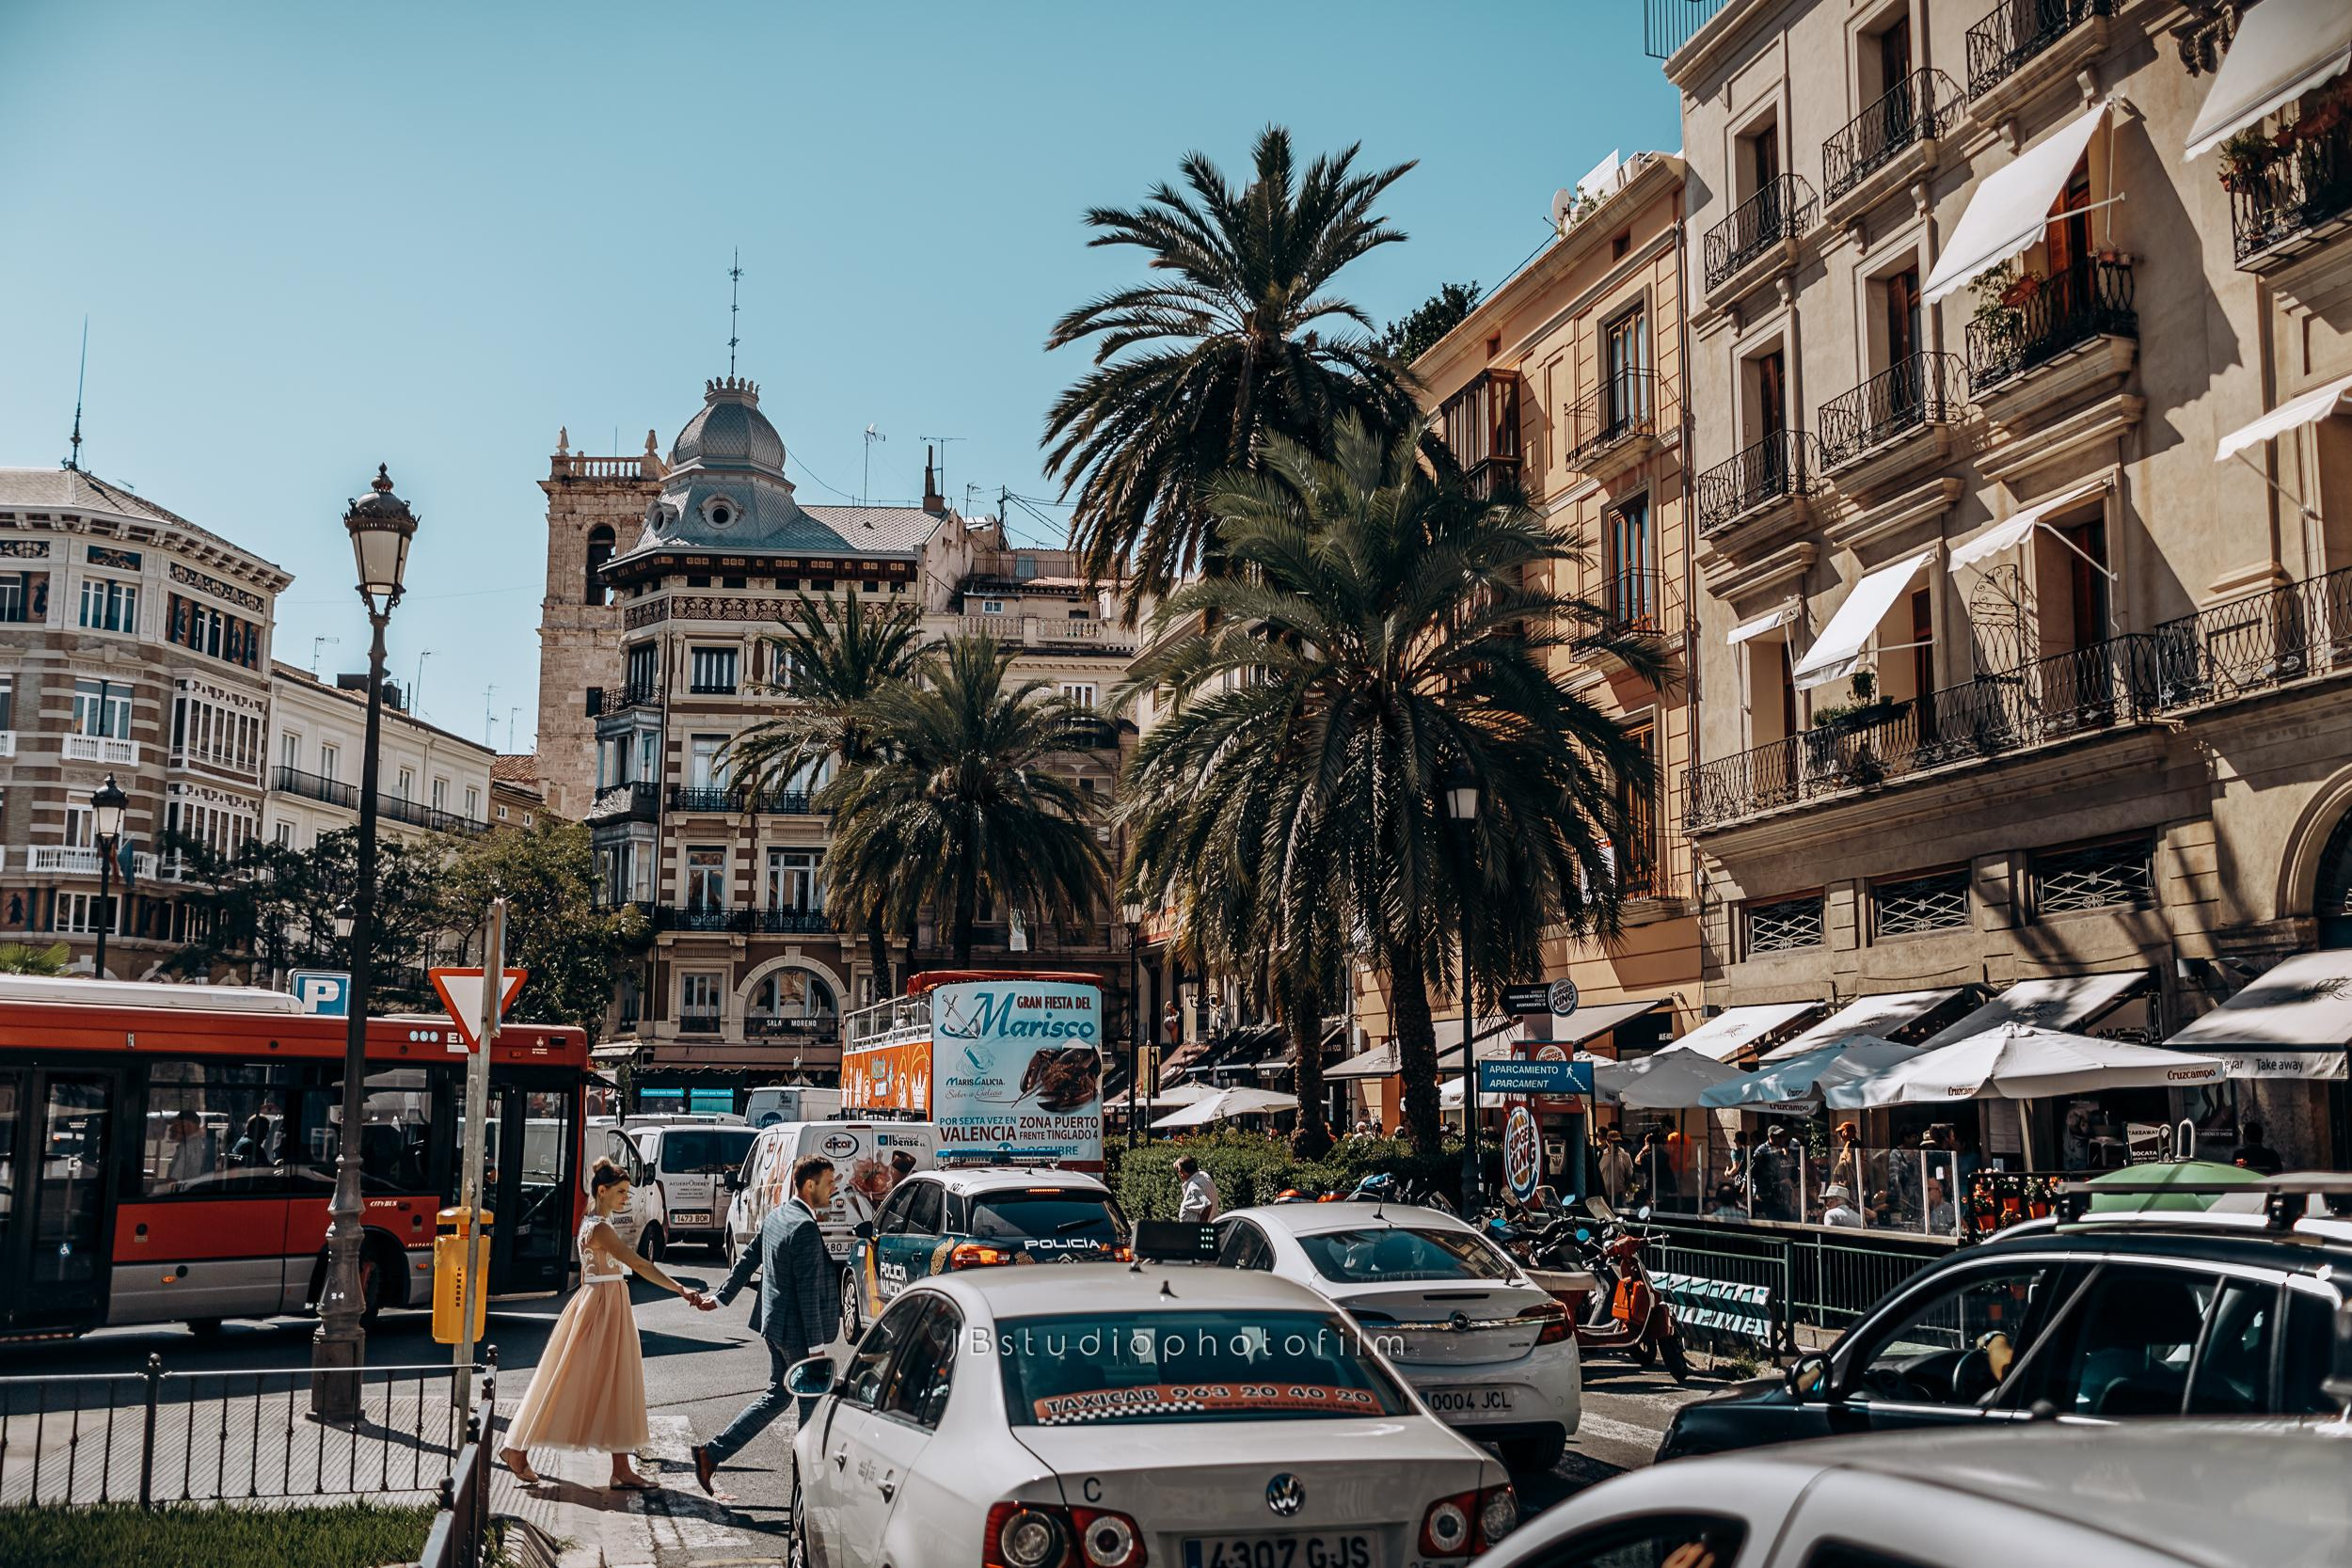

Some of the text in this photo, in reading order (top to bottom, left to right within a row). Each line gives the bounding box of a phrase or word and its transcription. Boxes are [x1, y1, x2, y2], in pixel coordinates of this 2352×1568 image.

[304, 979, 340, 1013] P
[1551, 985, 1573, 999] BURGER
[1552, 992, 1575, 1008] KING
[1017, 996, 1091, 1009] GRAN FIESTA DEL
[941, 992, 1095, 1038] Marisco
[1489, 1065, 1559, 1074] APARCAMIENTO
[2256, 1058, 2277, 1070] Take
[2279, 1059, 2303, 1073] away
[2168, 1069, 2217, 1081] Cruzcampo
[1489, 1079, 1549, 1088] APARCAMENT
[1770, 1102, 1810, 1112] Cruzcampo
[1020, 1117, 1099, 1129] ZONA PUERTO
[941, 1126, 1017, 1142] VALENCIA
[1019, 1130, 1099, 1140] FRENTE TINGLADO 4
[1509, 1126, 1534, 1156] BURGER
[1510, 1142, 1536, 1175] KING
[1045, 1385, 1373, 1415] TAXICAB 963 20 40 20
[1432, 1392, 1512, 1410] 0004 JCL
[1083, 1477, 1103, 1503] C
[1212, 1536, 1370, 1568] 4307 GJS
